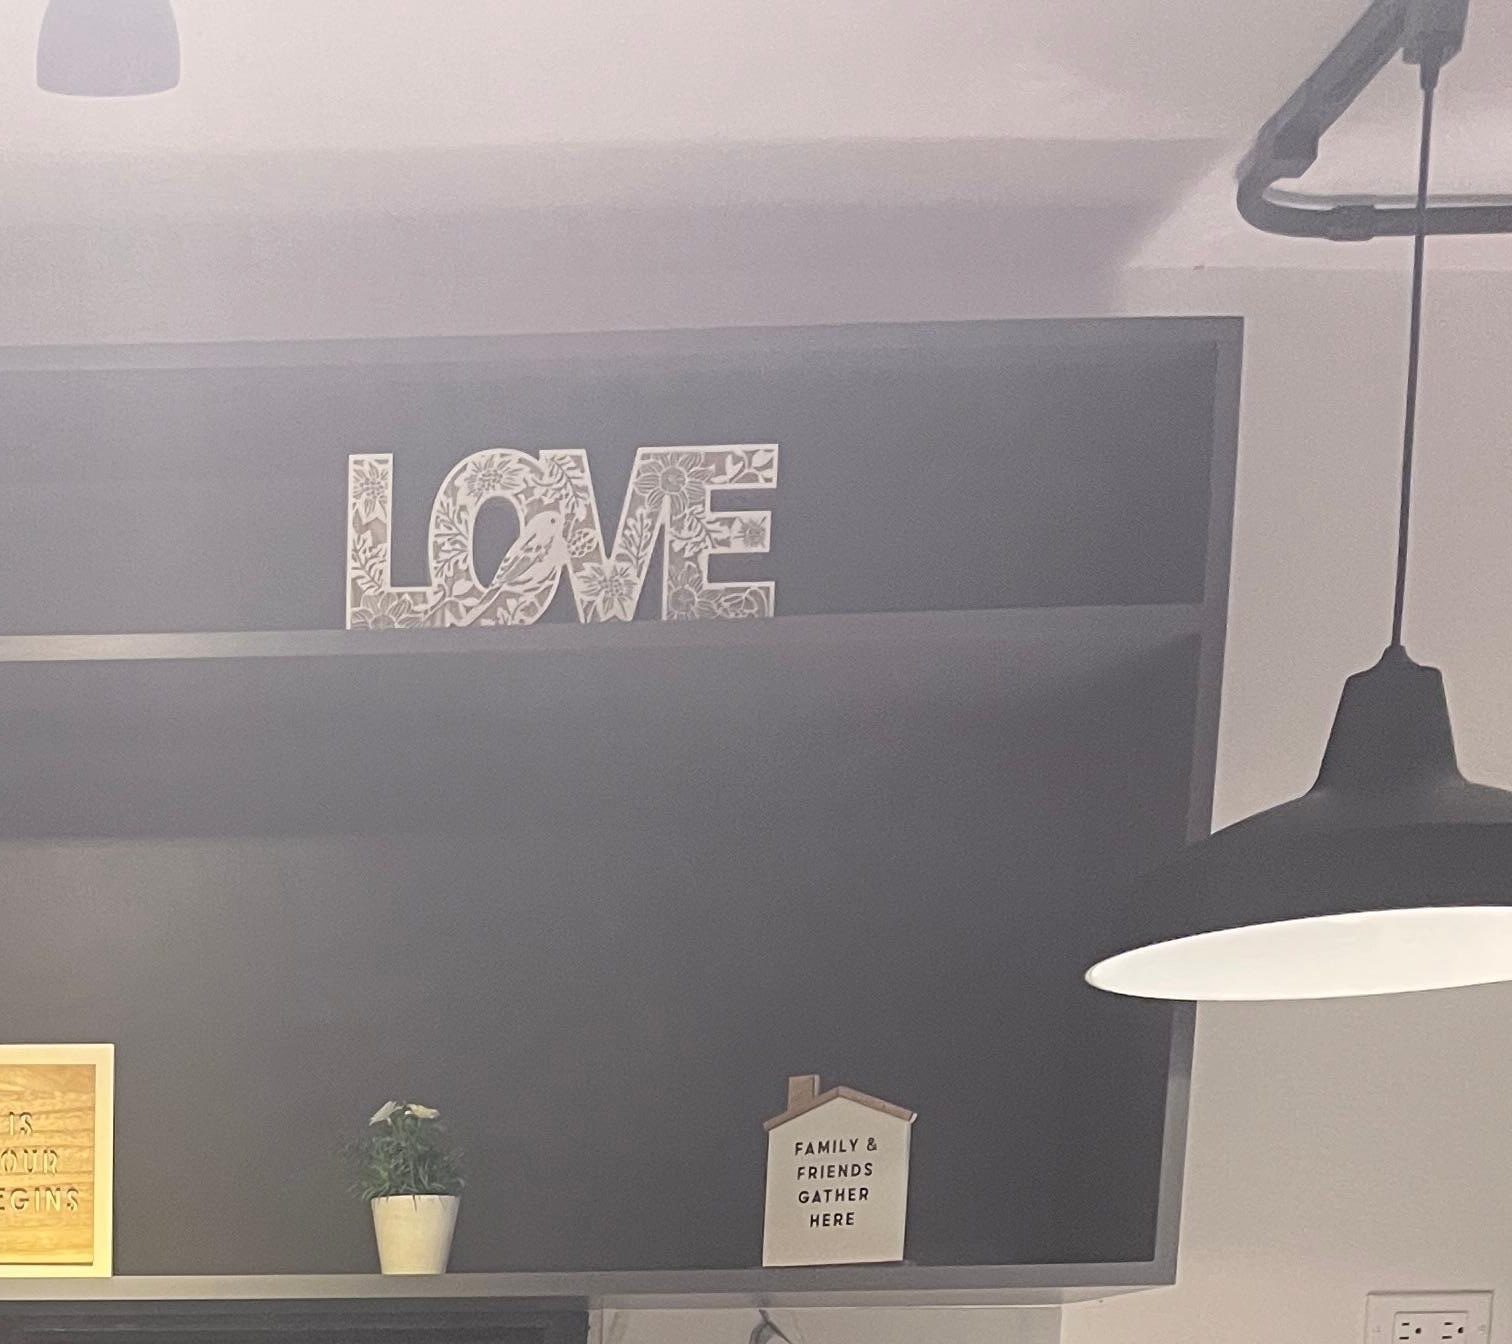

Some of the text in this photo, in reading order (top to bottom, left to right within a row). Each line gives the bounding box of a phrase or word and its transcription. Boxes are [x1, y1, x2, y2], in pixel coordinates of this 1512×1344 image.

[346, 443, 780, 630] LOVE
[8, 1111, 35, 1136] IS
[794, 1137, 878, 1155] FAMILY &
[0, 1149, 59, 1174] OUR
[796, 1162, 873, 1180] FRIENDS
[797, 1186, 869, 1204] GATHER
[809, 1211, 855, 1228] HERE
